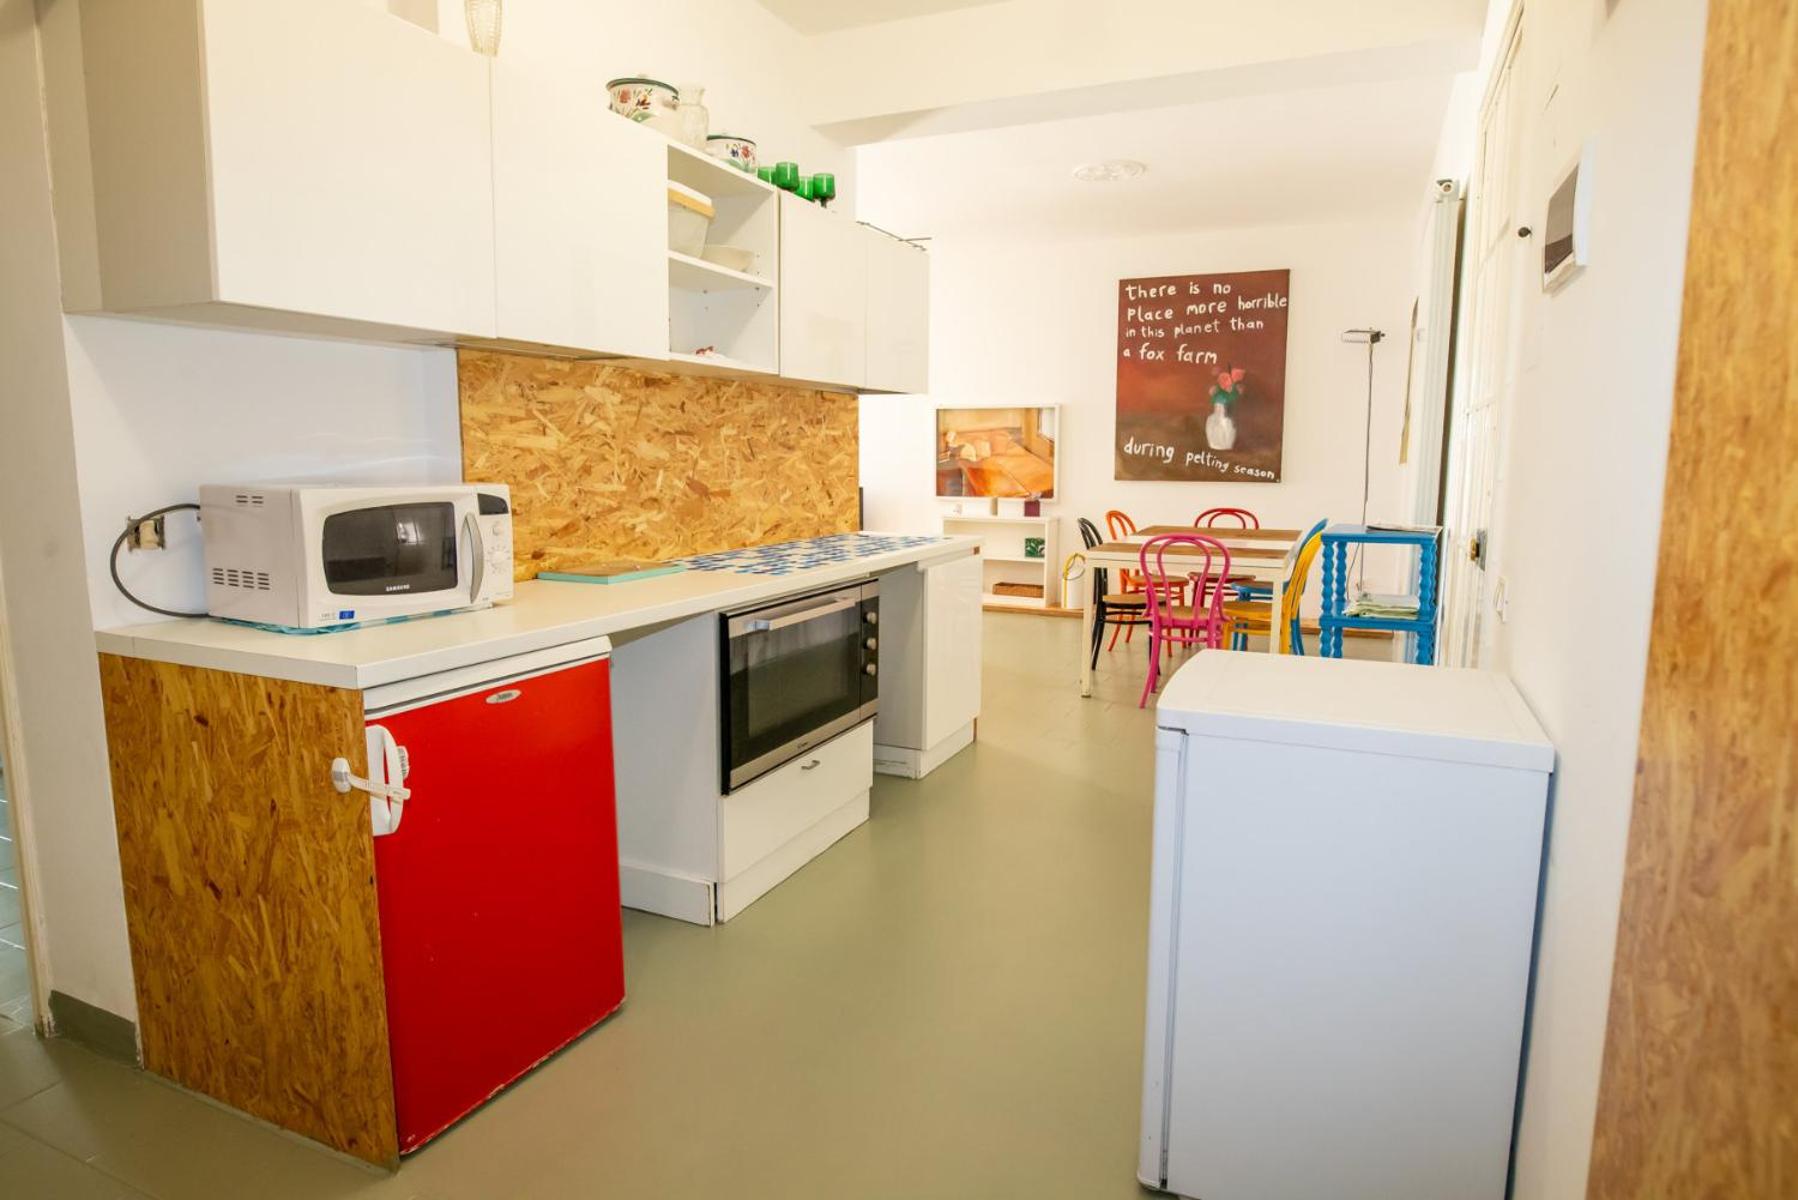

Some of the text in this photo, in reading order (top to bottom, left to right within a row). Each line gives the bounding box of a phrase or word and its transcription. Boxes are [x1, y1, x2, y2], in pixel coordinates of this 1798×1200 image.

[1125, 282, 1231, 300] there is no
[1186, 301, 1227, 315] more
[1238, 293, 1287, 311] horrible
[1125, 317, 1264, 339] in this planet than
[1123, 343, 1218, 364] a fox farm
[1123, 436, 1275, 480] during pelting season
